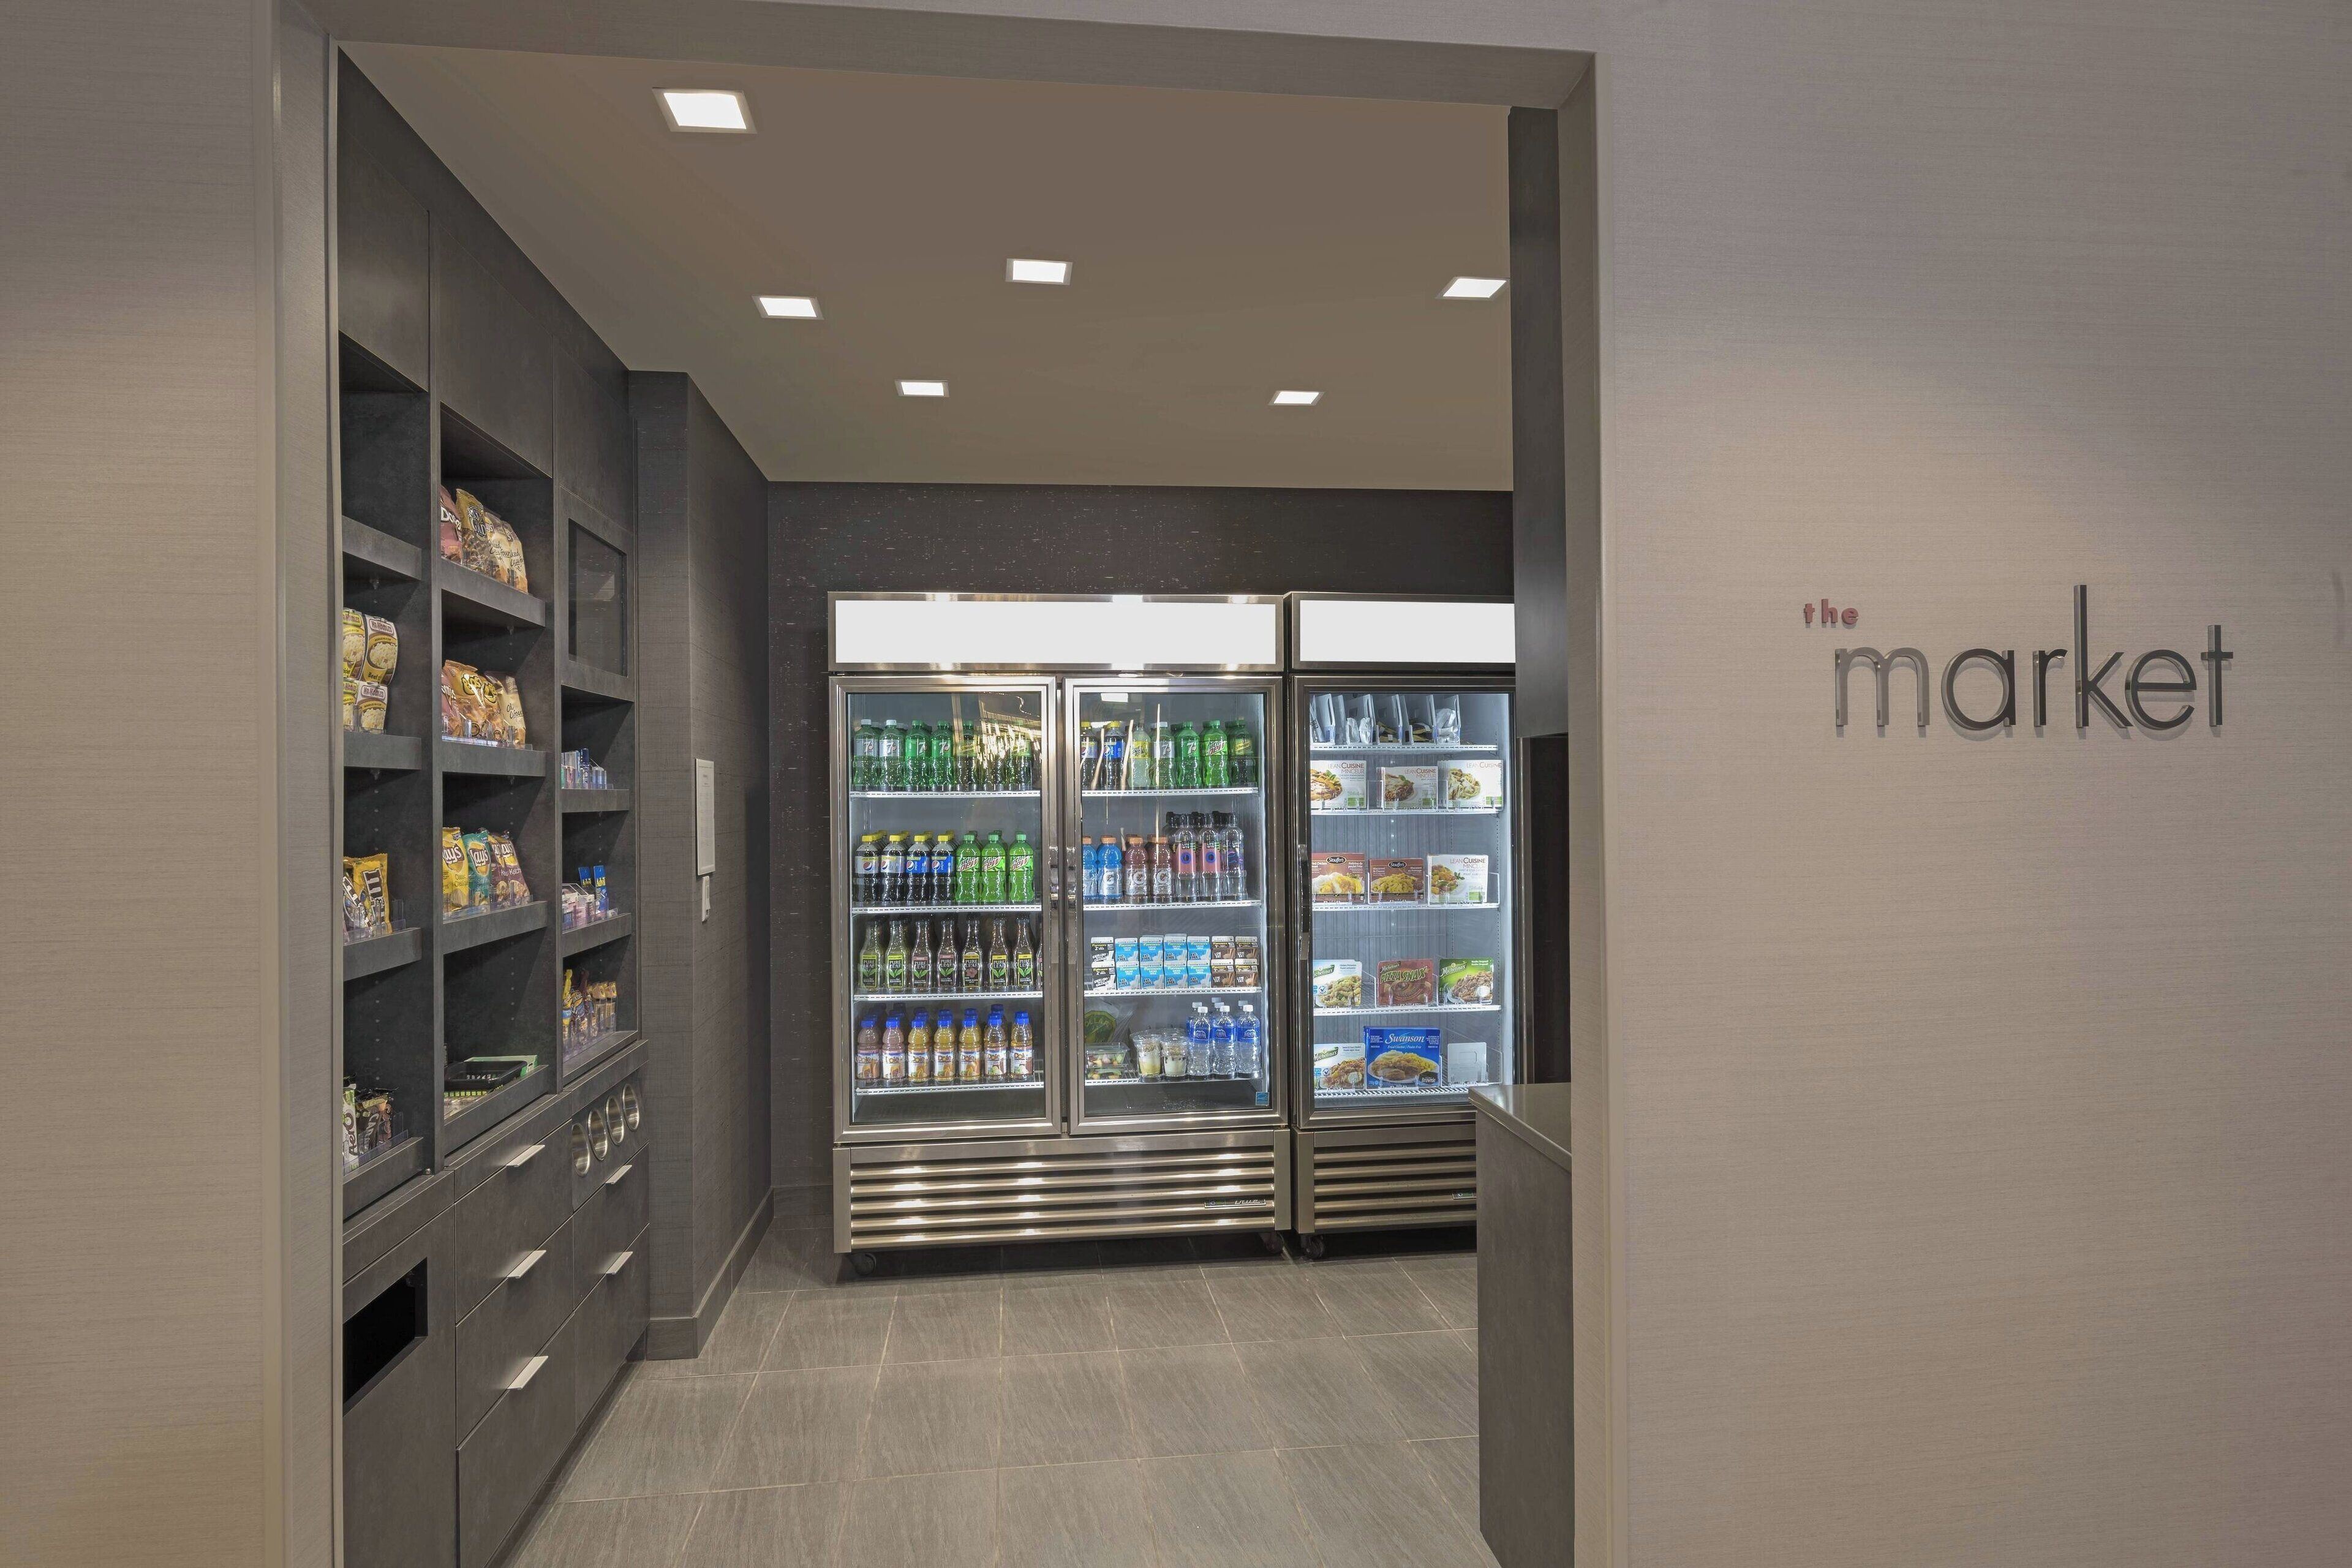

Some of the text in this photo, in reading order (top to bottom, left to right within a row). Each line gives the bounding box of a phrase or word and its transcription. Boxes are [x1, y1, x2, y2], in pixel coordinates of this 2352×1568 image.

[1804, 598, 1859, 625] the
[1834, 584, 2234, 730] market
[443, 845, 462, 864] ay's
[469, 847, 489, 867] Lay's
[1380, 966, 1428, 984] PIZZA SNAX
[1439, 963, 1466, 977] Michelina's
[1385, 1033, 1425, 1044] Swanson
